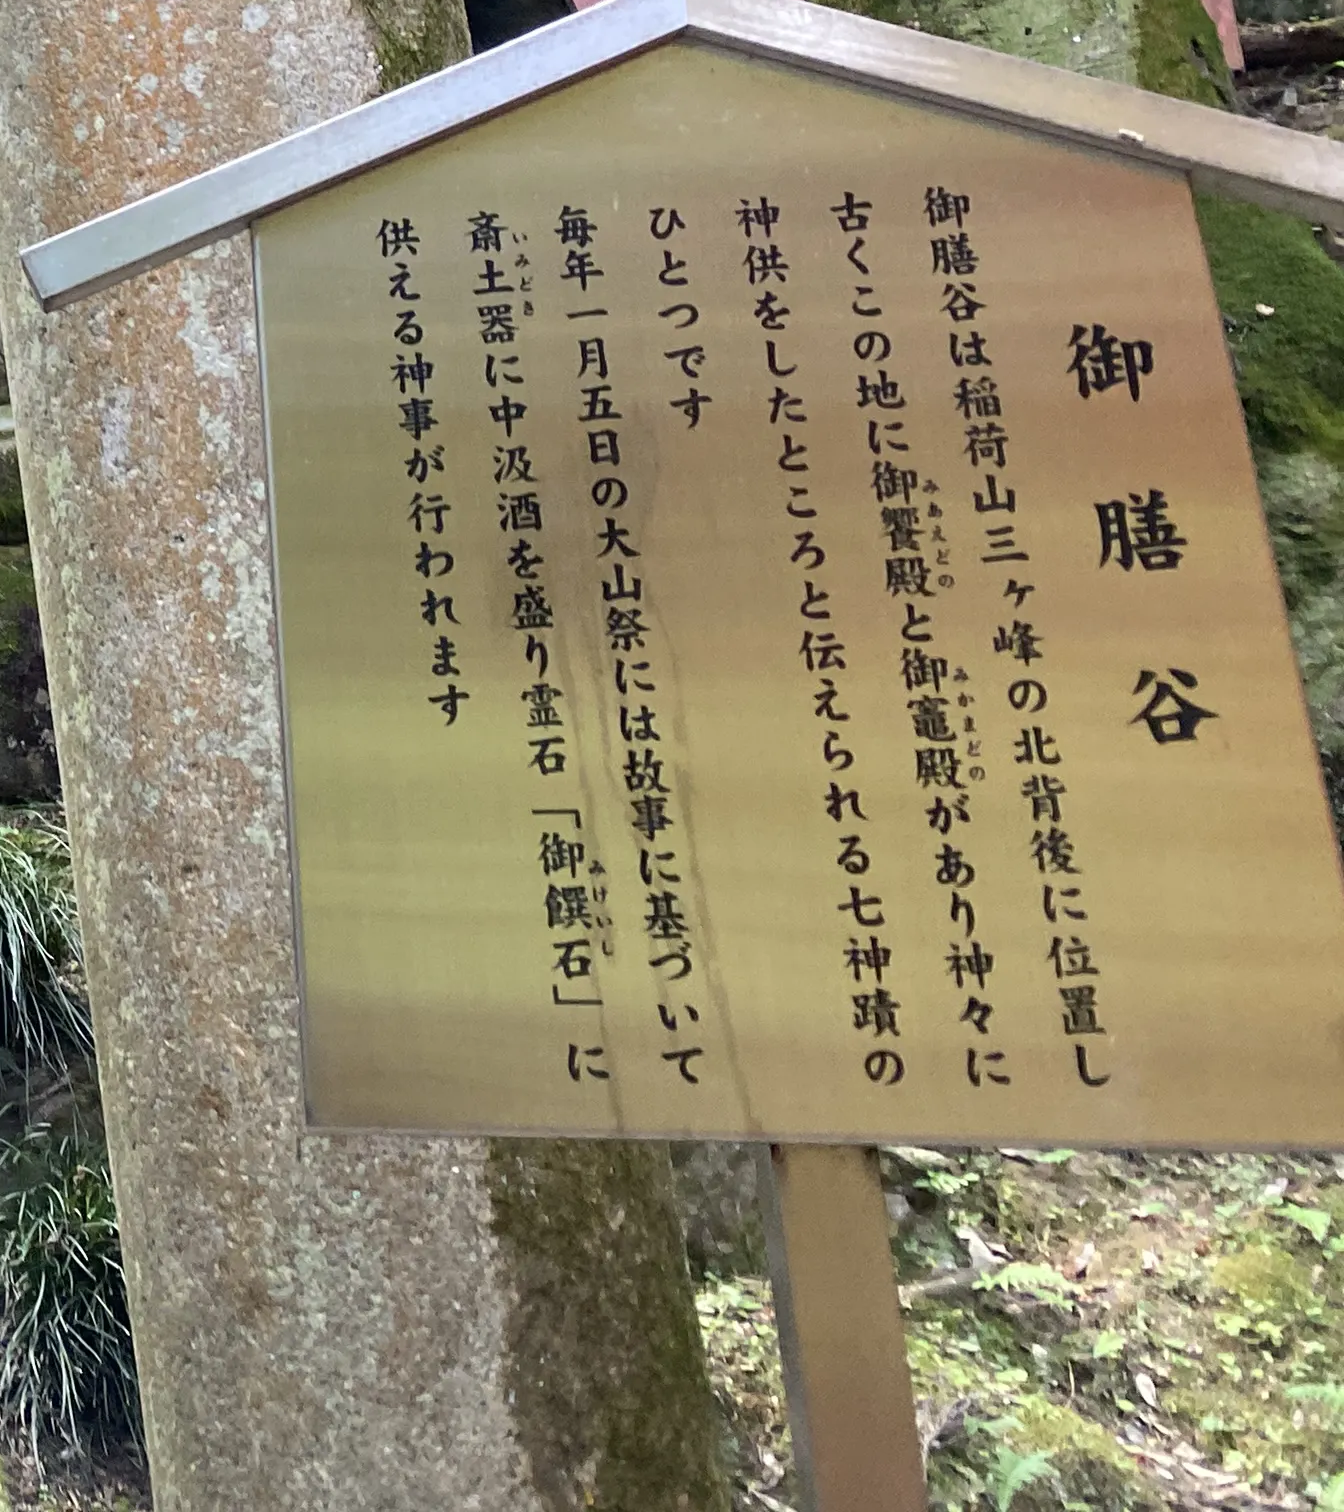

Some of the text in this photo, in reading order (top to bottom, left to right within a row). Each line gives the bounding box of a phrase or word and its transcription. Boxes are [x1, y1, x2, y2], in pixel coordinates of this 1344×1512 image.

[512, 232, 534, 316] いみどき
[648, 206, 713, 429] ひとつです
[375, 218, 470, 727] 供える神事が行われます
[553, 205, 704, 1085] 毎年一月五日の大山祭には故事に基づいて
[735, 196, 905, 1086] 神供をしたところと伝えられる七神蹟の
[952, 666, 986, 781] みかまどの
[588, 859, 614, 956] みけいし
